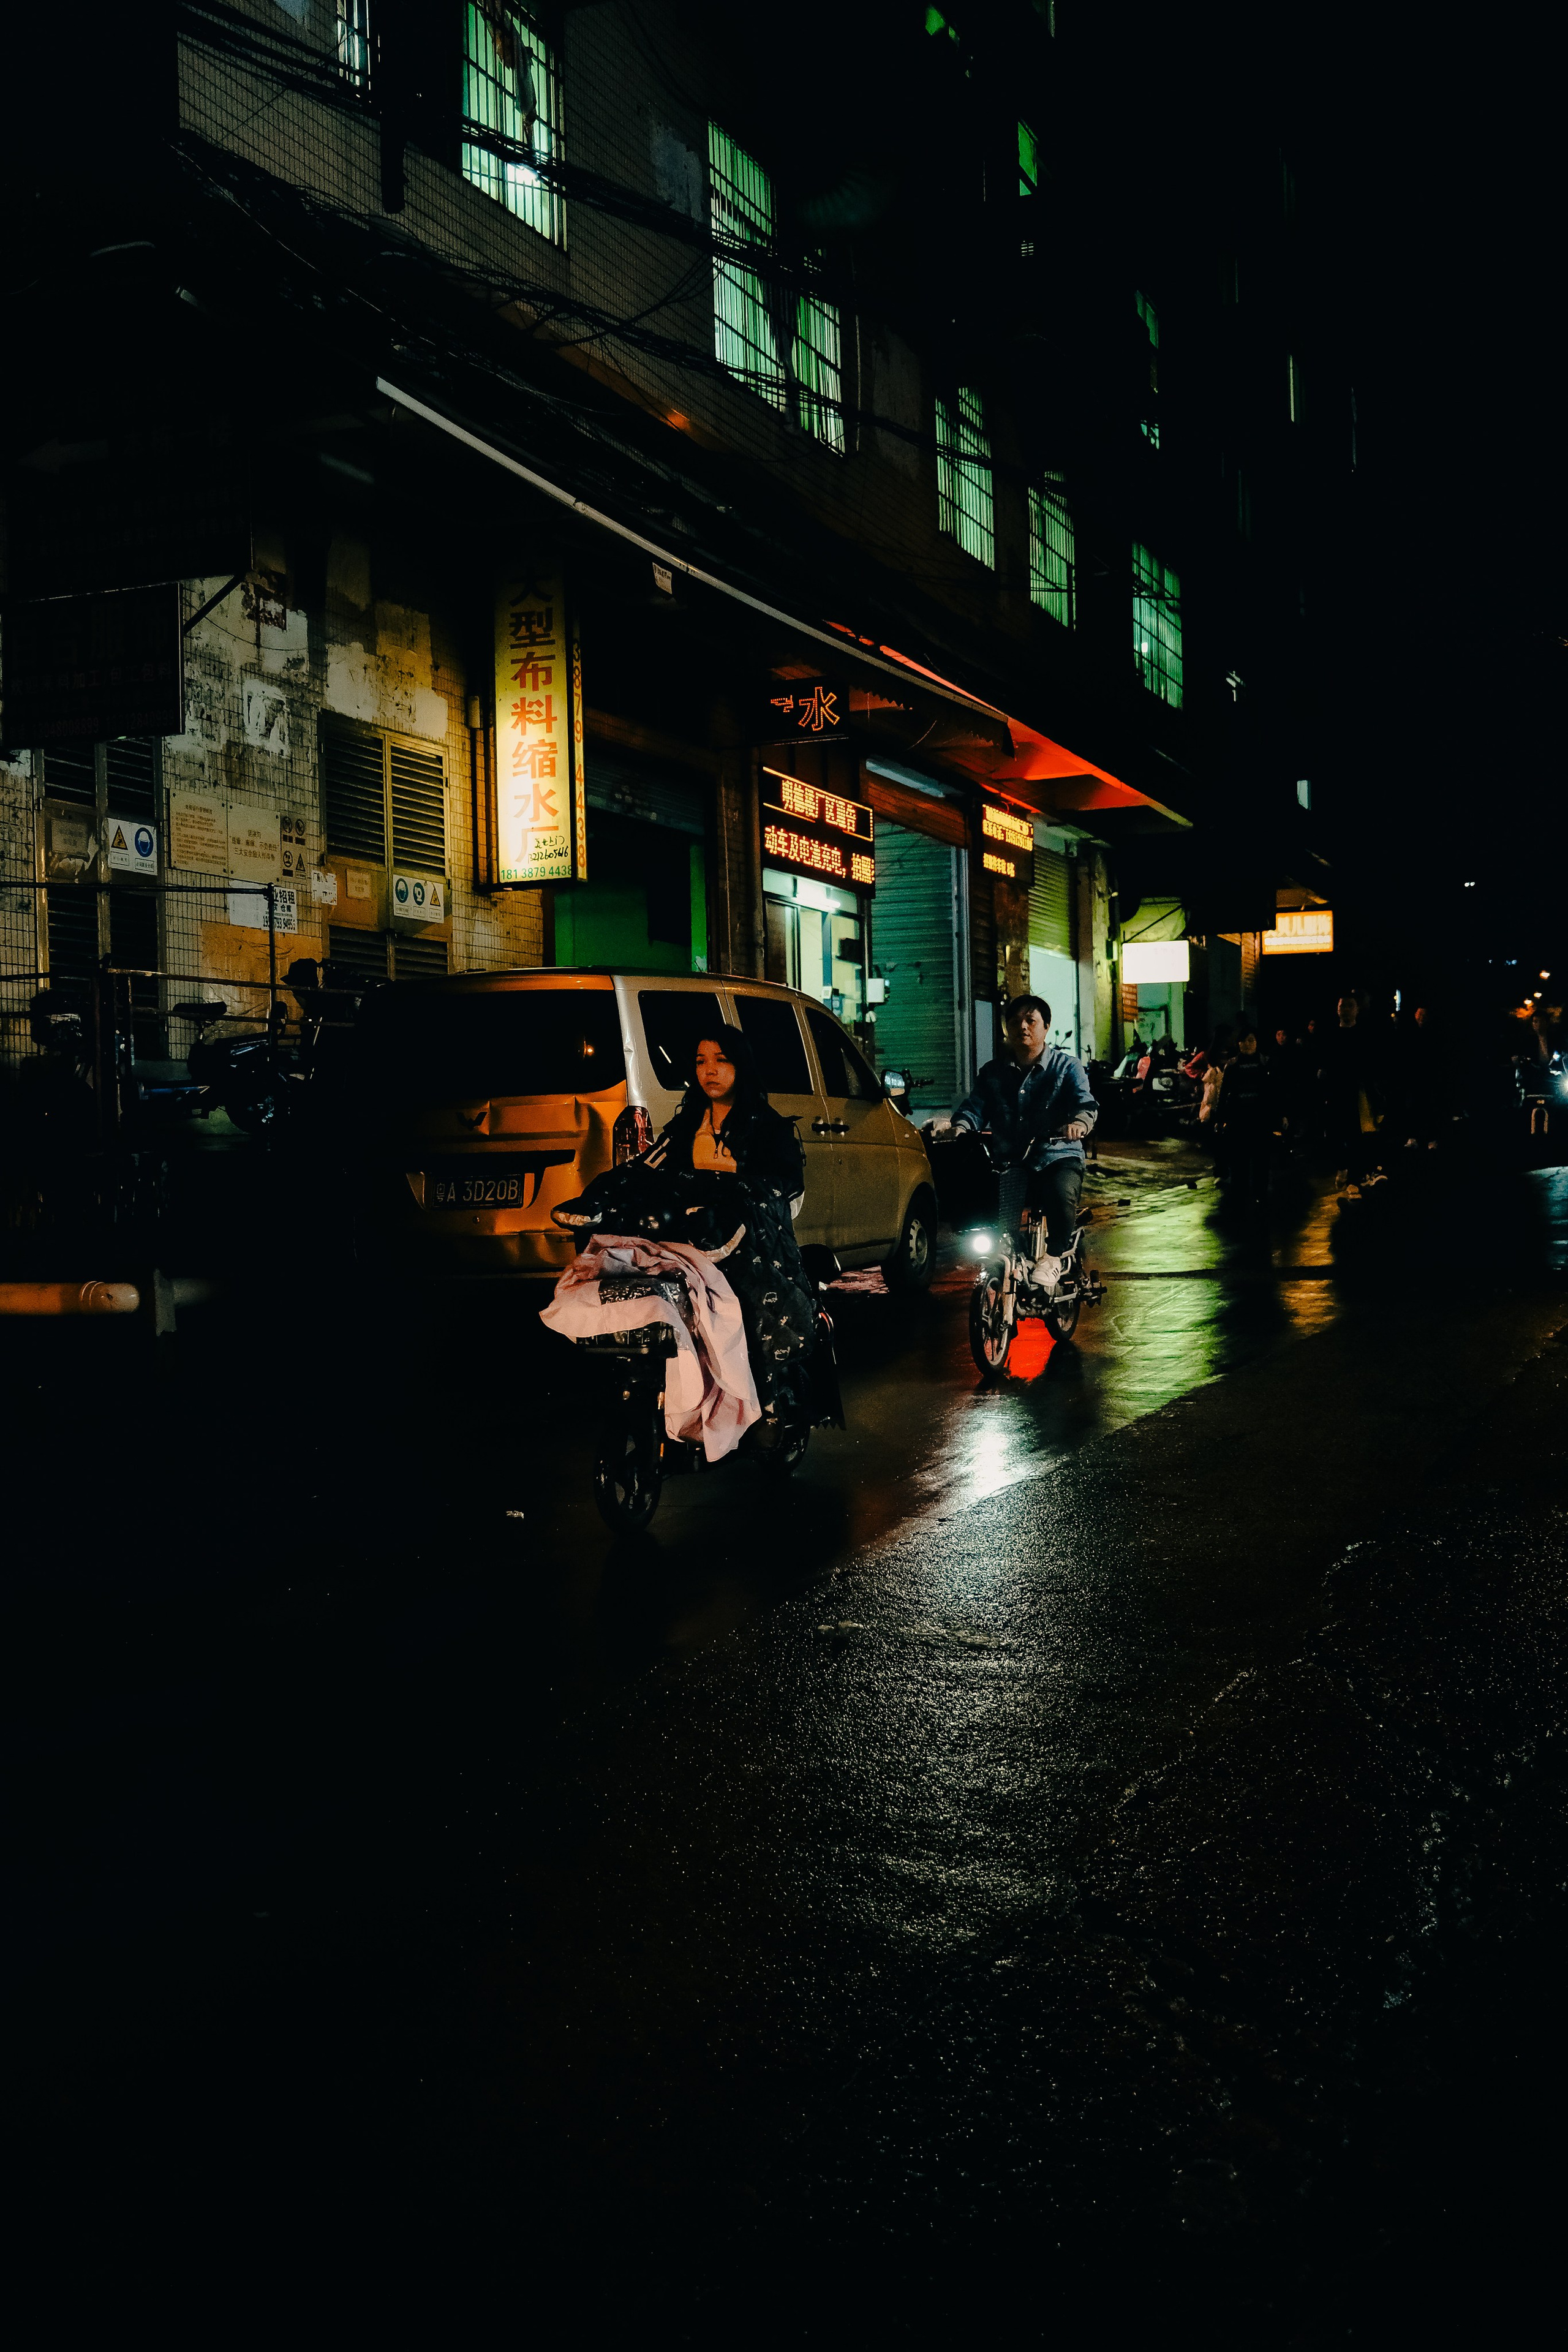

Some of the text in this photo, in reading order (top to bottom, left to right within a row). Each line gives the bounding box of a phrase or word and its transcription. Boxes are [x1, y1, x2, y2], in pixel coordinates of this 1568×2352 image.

[8, 594, 170, 672] 百合服饰
[508, 567, 560, 864] 大型布料缩水厂
[574, 764, 587, 869] 4438
[500, 864, 571, 880] 181 3879 4438
